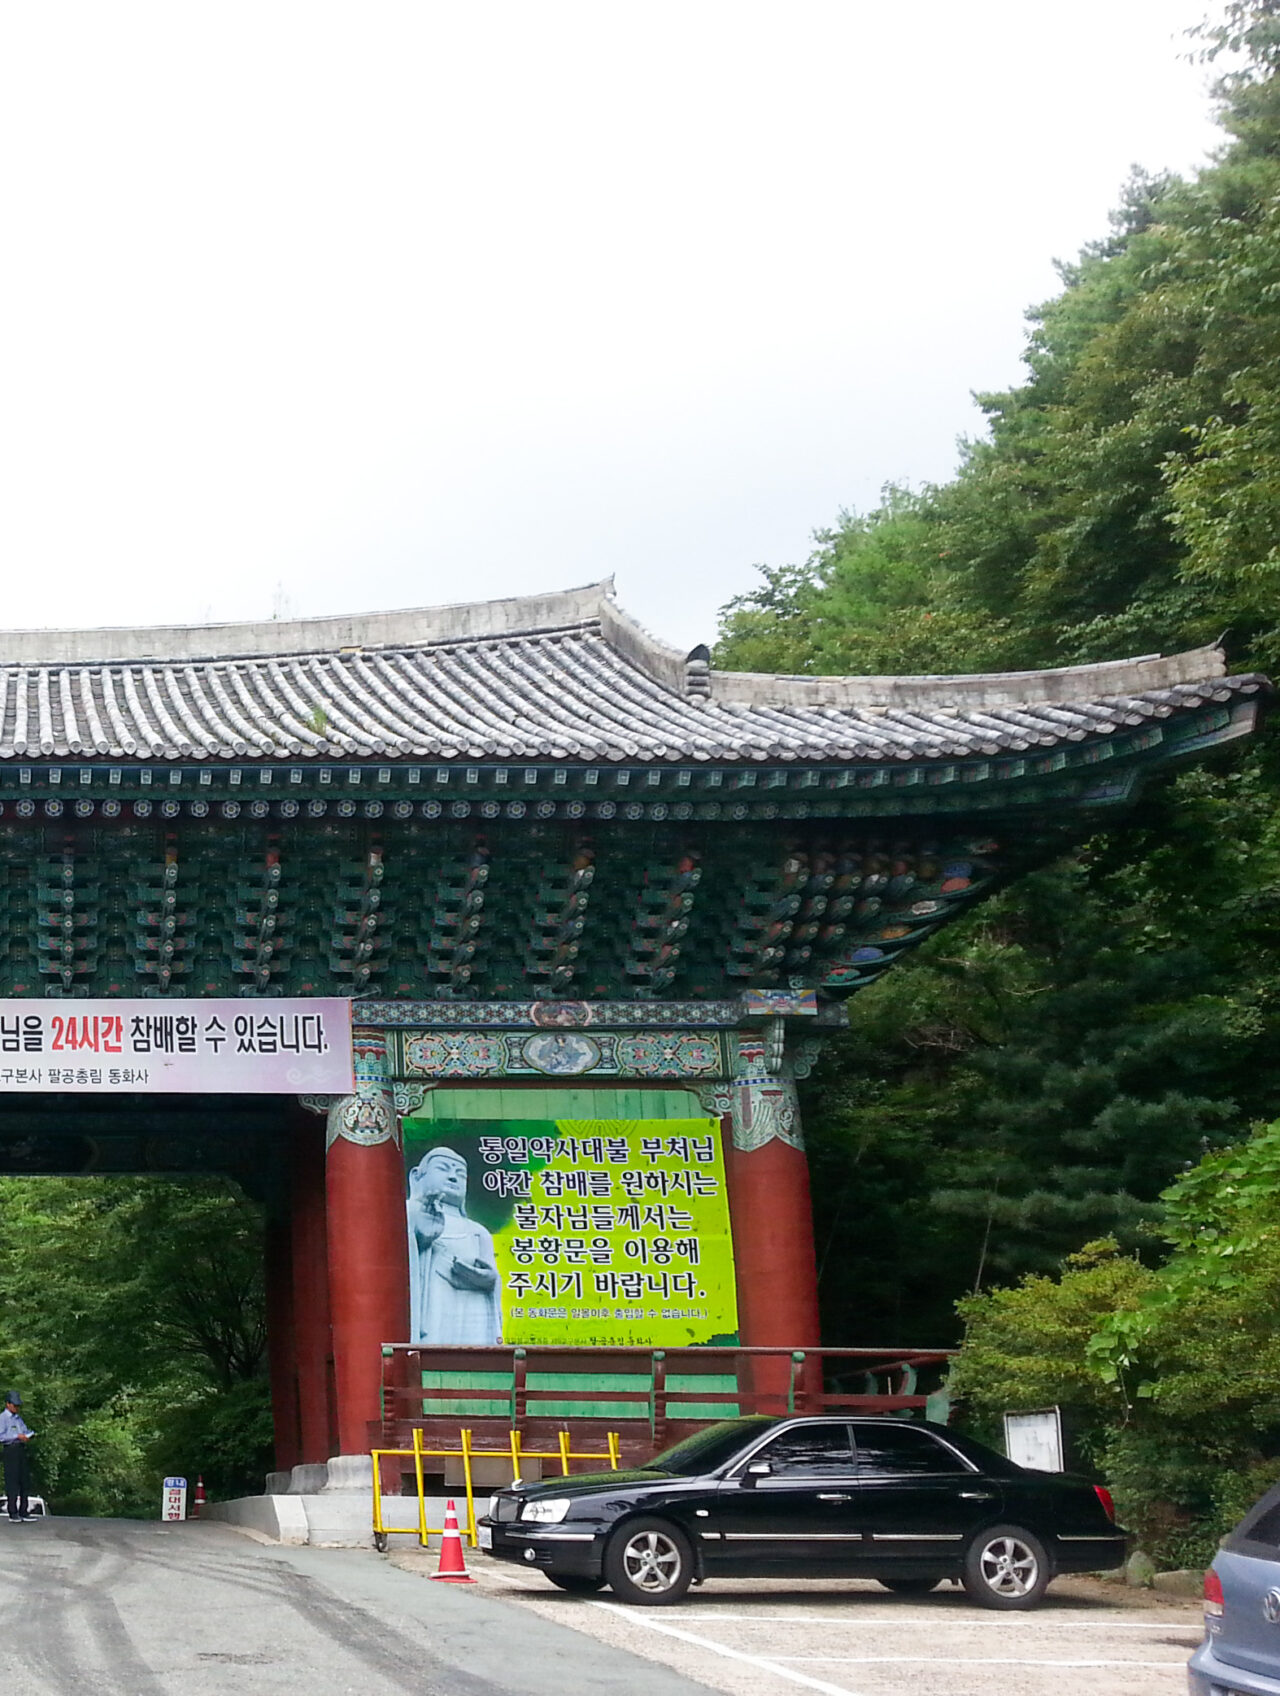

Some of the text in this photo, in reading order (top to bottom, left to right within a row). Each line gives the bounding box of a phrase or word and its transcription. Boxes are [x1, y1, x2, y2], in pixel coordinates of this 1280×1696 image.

[51, 1015, 124, 1053] 24시간
[130, 1015, 198, 1053] 참배할
[204, 1016, 226, 1054] 수
[234, 1014, 328, 1054] 있습니다.
[48, 1068, 102, 1084] 팔공총림
[108, 1068, 149, 1085] 동화사
[480, 1136, 713, 1164] 통일약사대불 부처님
[485, 1170, 717, 1197] 야간 참배를 원하시는
[515, 1204, 692, 1231] 불자님들께서는
[513, 1237, 700, 1265] 봉황문을 이용해
[509, 1272, 705, 1299] 주시기 바랍니다.
[648, 1309, 658, 1319] 수
